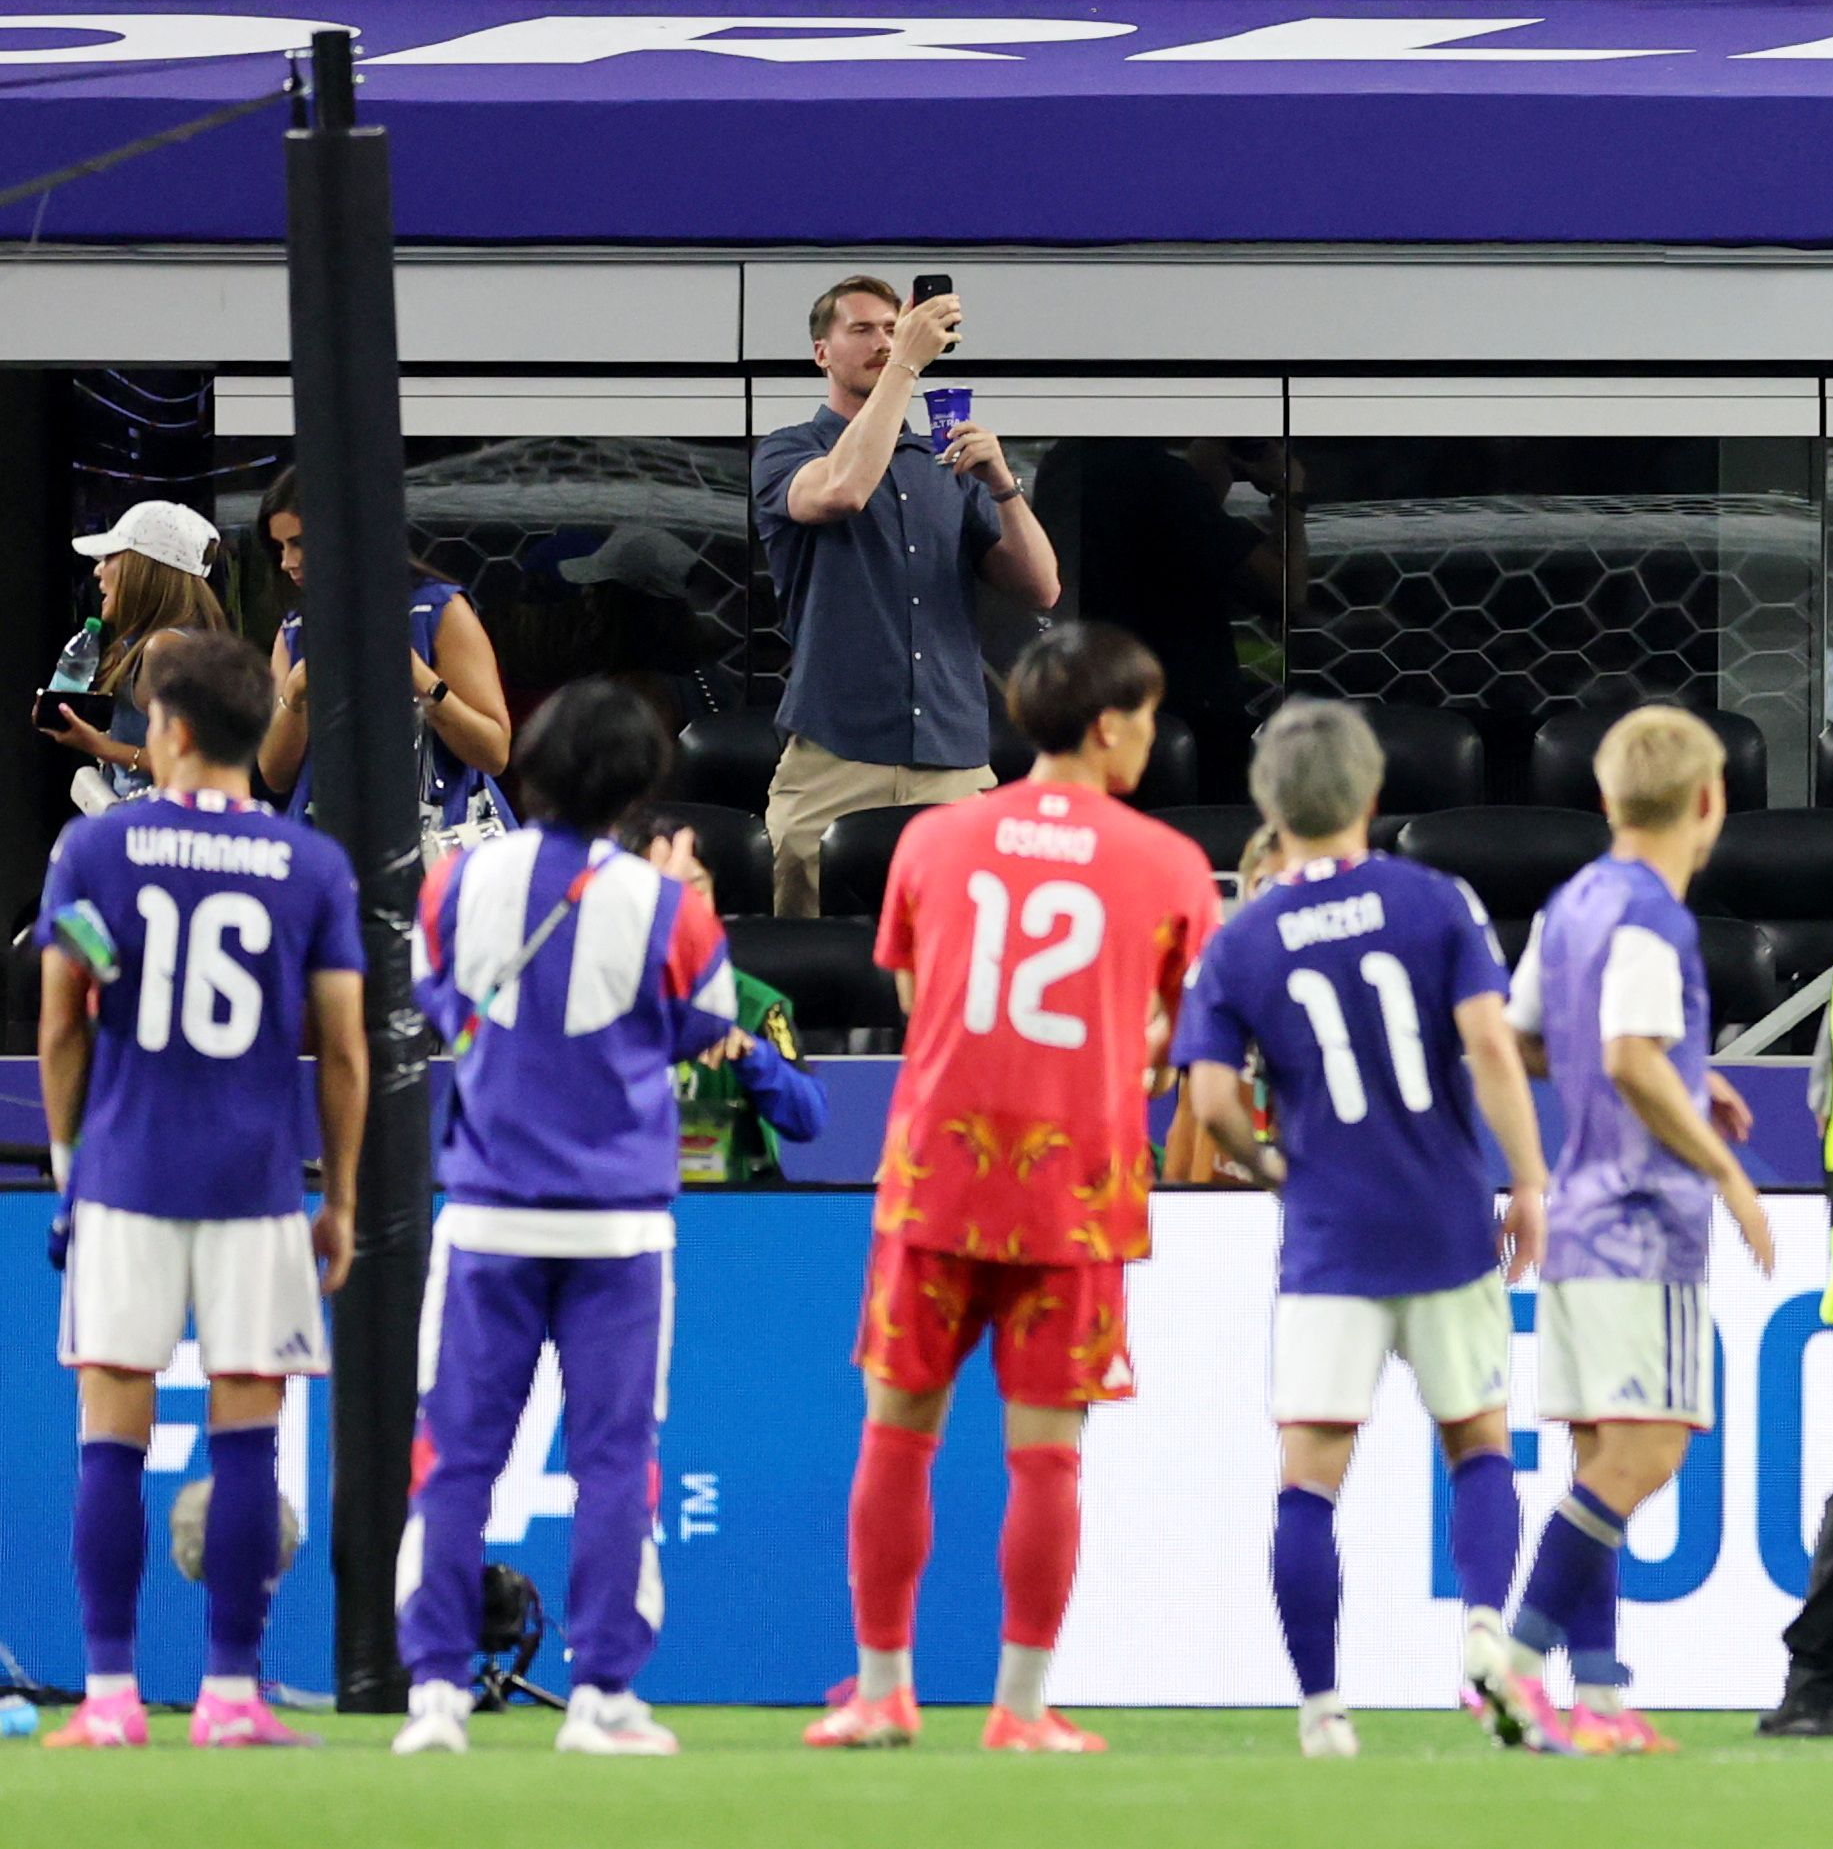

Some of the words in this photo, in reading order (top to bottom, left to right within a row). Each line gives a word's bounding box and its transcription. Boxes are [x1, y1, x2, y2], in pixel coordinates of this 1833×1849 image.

[125, 825, 292, 880] WATANABE
[995, 817, 1098, 865] OSAKO
[135, 883, 273, 1060] 16
[965, 869, 1105, 1047] 12
[1286, 950, 1436, 1125] 11
